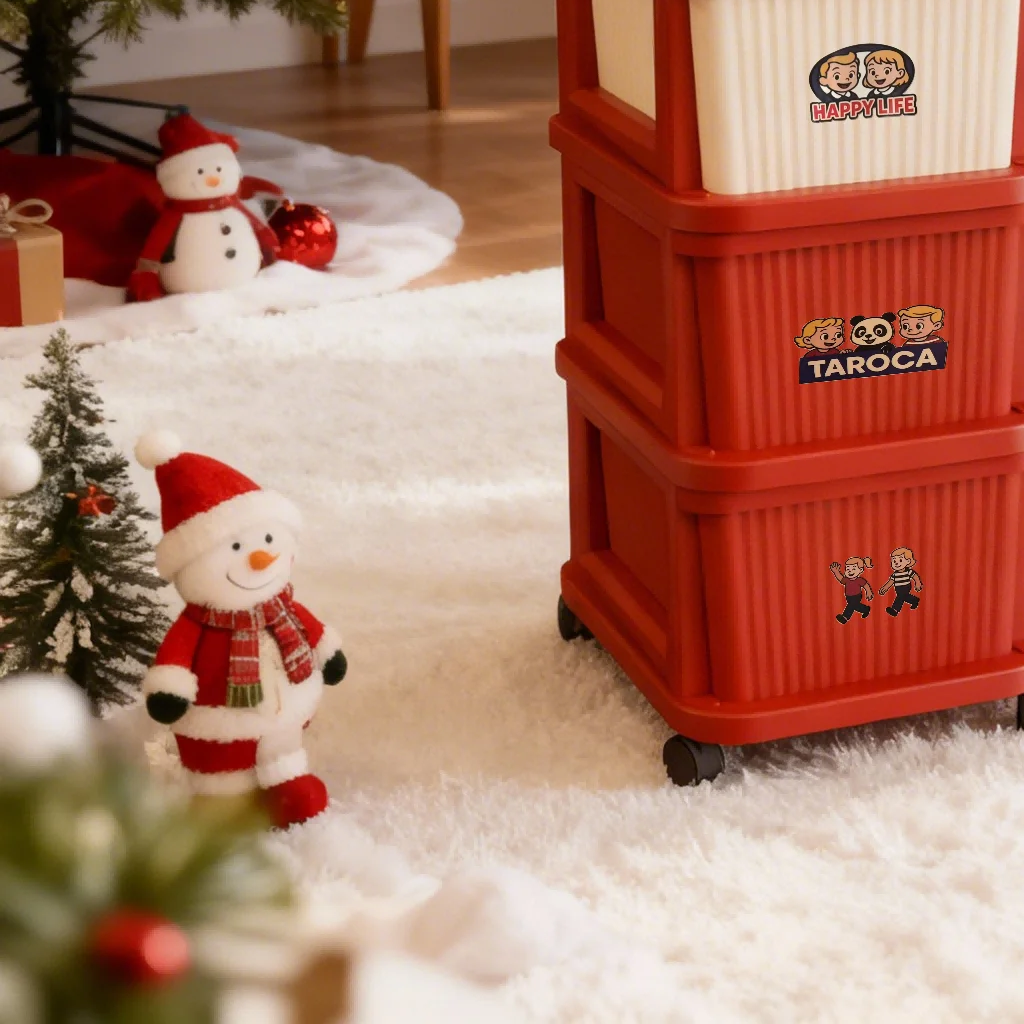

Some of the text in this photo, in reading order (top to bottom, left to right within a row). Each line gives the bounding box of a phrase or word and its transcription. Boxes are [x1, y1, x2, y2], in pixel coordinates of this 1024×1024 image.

[812, 96, 915, 120] HAPPY LIFE
[807, 347, 938, 378] TAROCA
